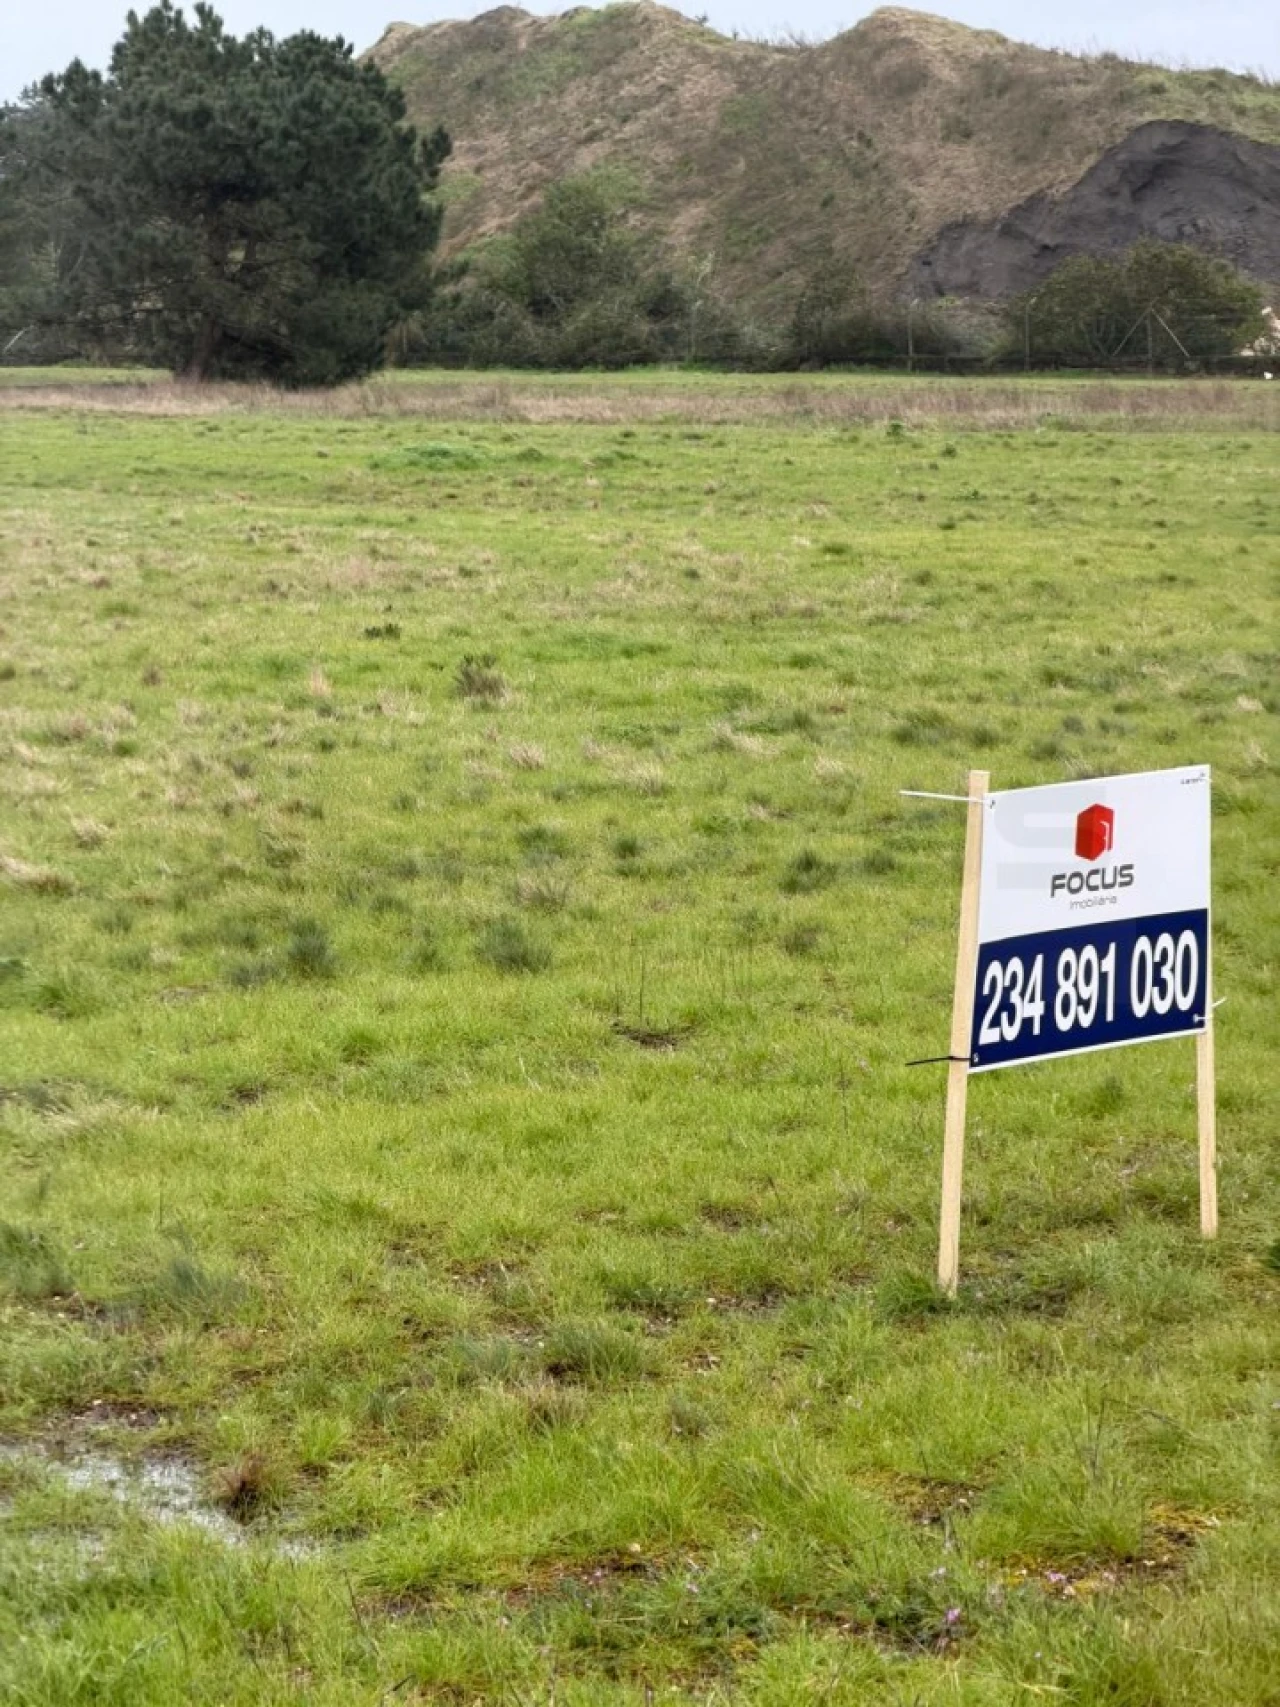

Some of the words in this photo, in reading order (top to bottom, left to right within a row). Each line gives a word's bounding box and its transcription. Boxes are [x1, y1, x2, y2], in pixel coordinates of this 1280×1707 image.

[1050, 863, 1135, 898] FOCUS
[978, 954, 1045, 1045] 234
[1054, 942, 1116, 1031] 891
[1130, 929, 1198, 1018] 030
